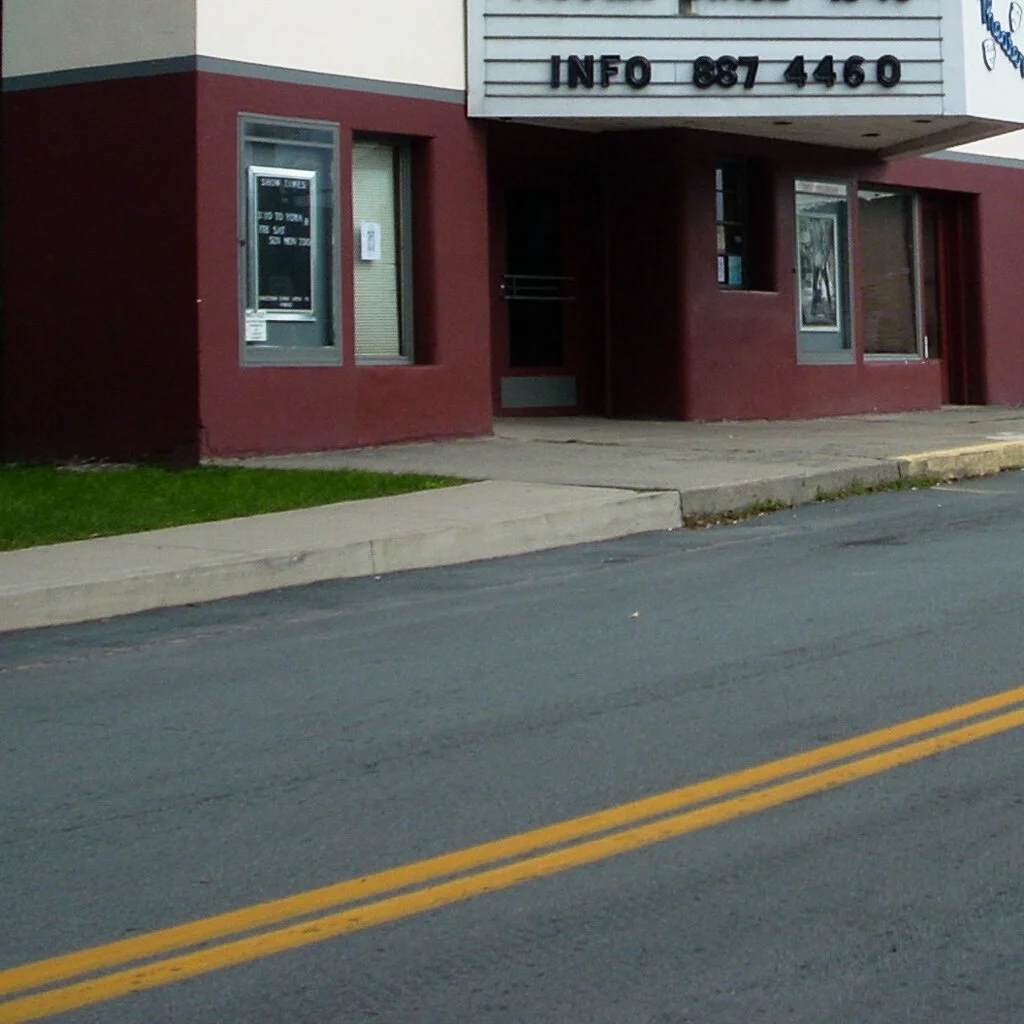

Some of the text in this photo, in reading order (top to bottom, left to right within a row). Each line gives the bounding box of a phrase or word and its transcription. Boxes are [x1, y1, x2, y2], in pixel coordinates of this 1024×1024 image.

[550, 54, 902, 90] INFO 887 4460
